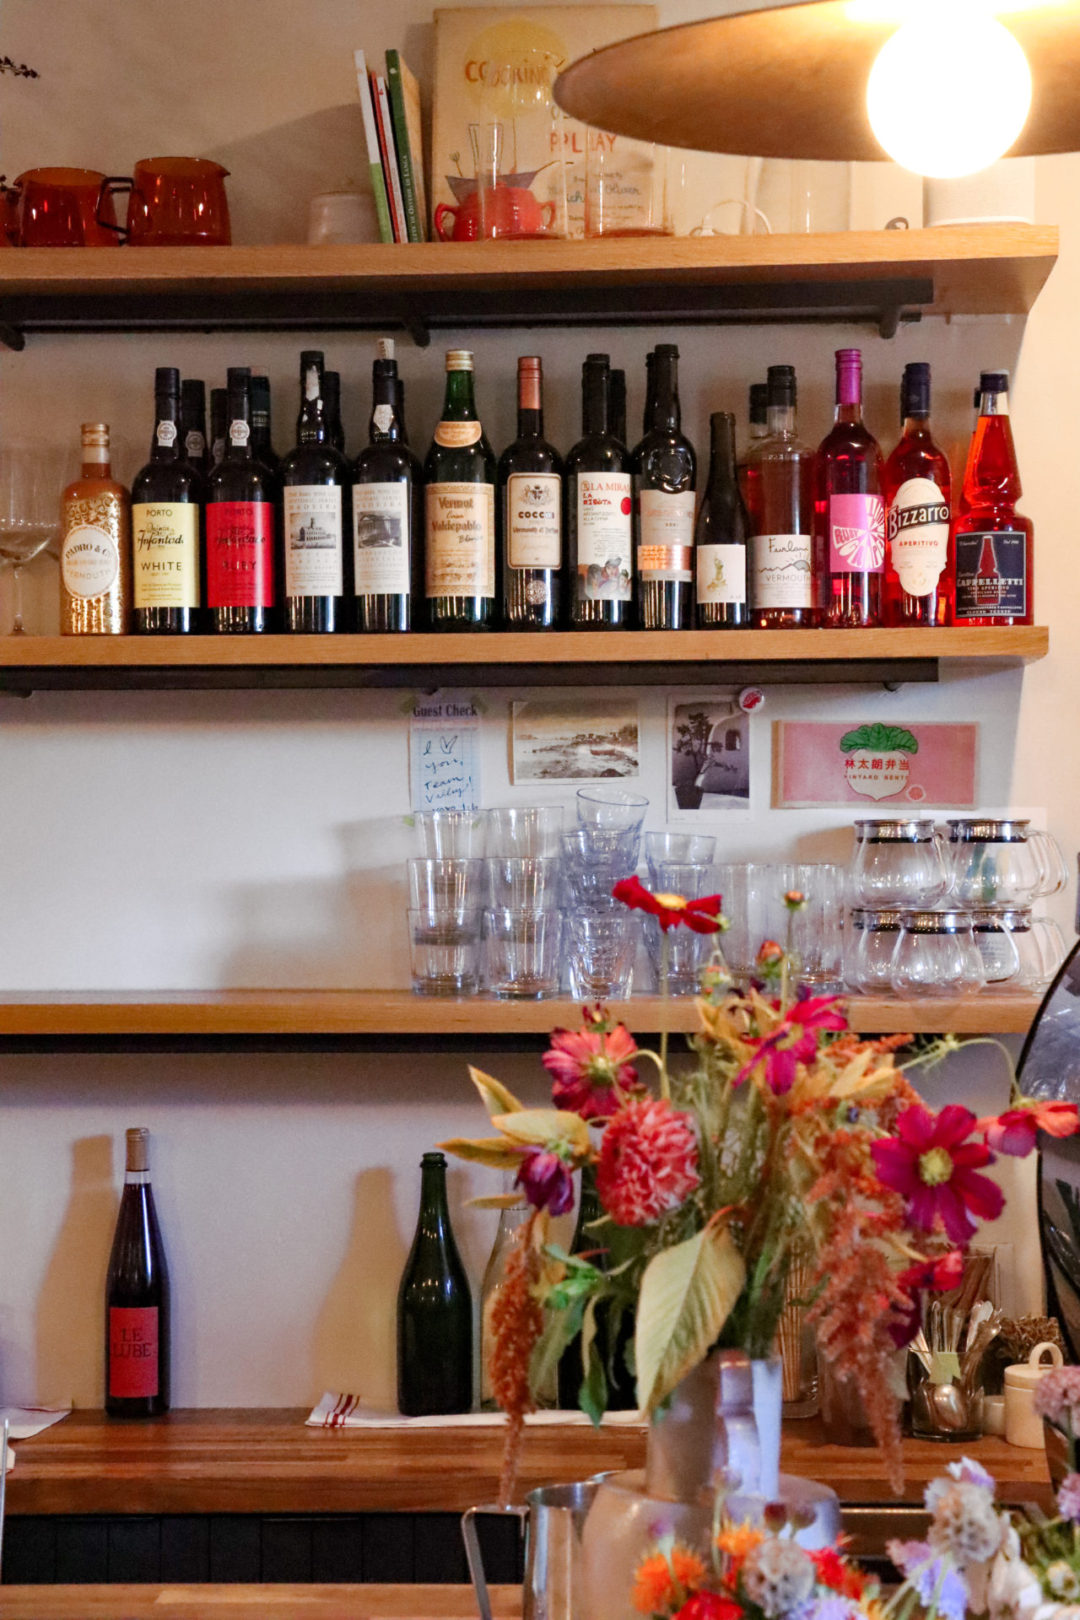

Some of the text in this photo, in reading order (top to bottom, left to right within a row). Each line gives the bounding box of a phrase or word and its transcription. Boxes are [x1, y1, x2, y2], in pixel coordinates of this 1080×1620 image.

[146, 509, 173, 517] PORTO
[888, 506, 949, 540] Bizzarro
[141, 561, 183, 571] WHITE
[412, 704, 478, 717] Guest Check
[121, 1328, 144, 1342] LE
[113, 1343, 152, 1358] LUBE
